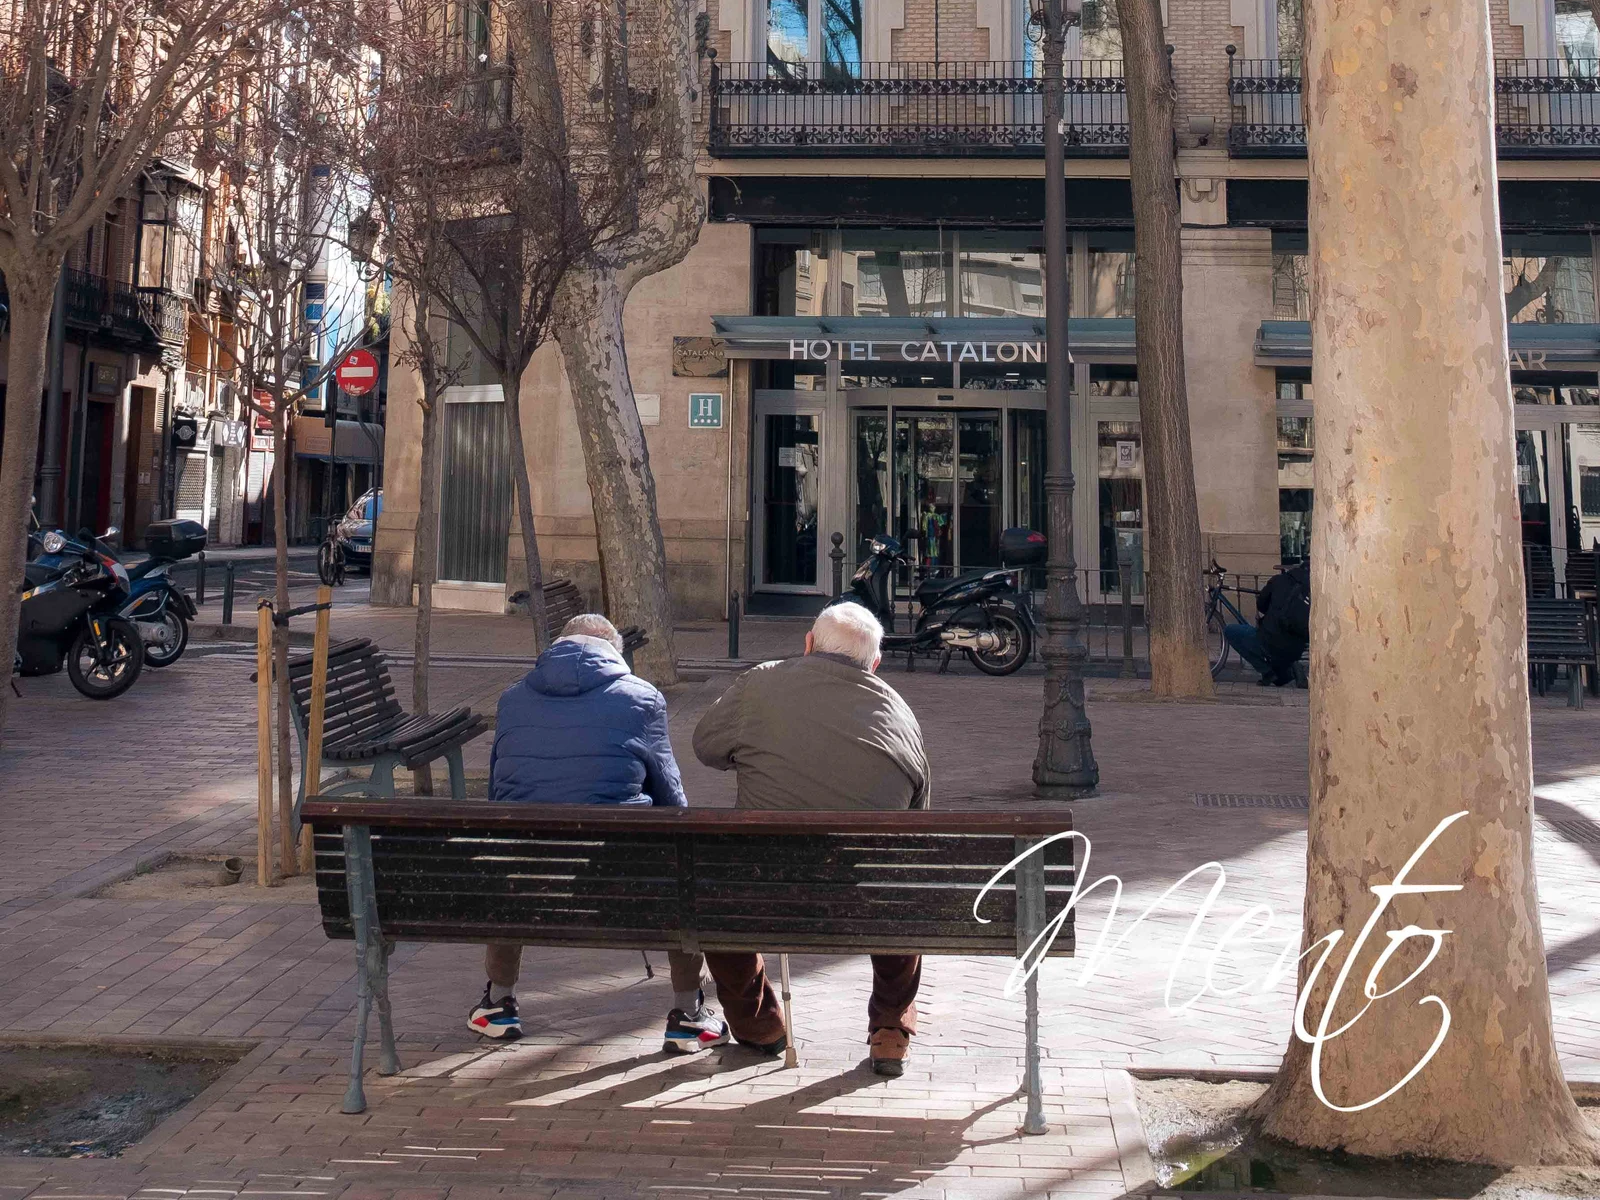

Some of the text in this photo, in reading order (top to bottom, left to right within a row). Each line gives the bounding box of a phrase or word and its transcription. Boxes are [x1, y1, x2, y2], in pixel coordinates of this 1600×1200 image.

[789, 339, 1075, 362] HOTEL CATALONI
[1509, 349, 1547, 370] AR
[698, 398, 714, 416] H
